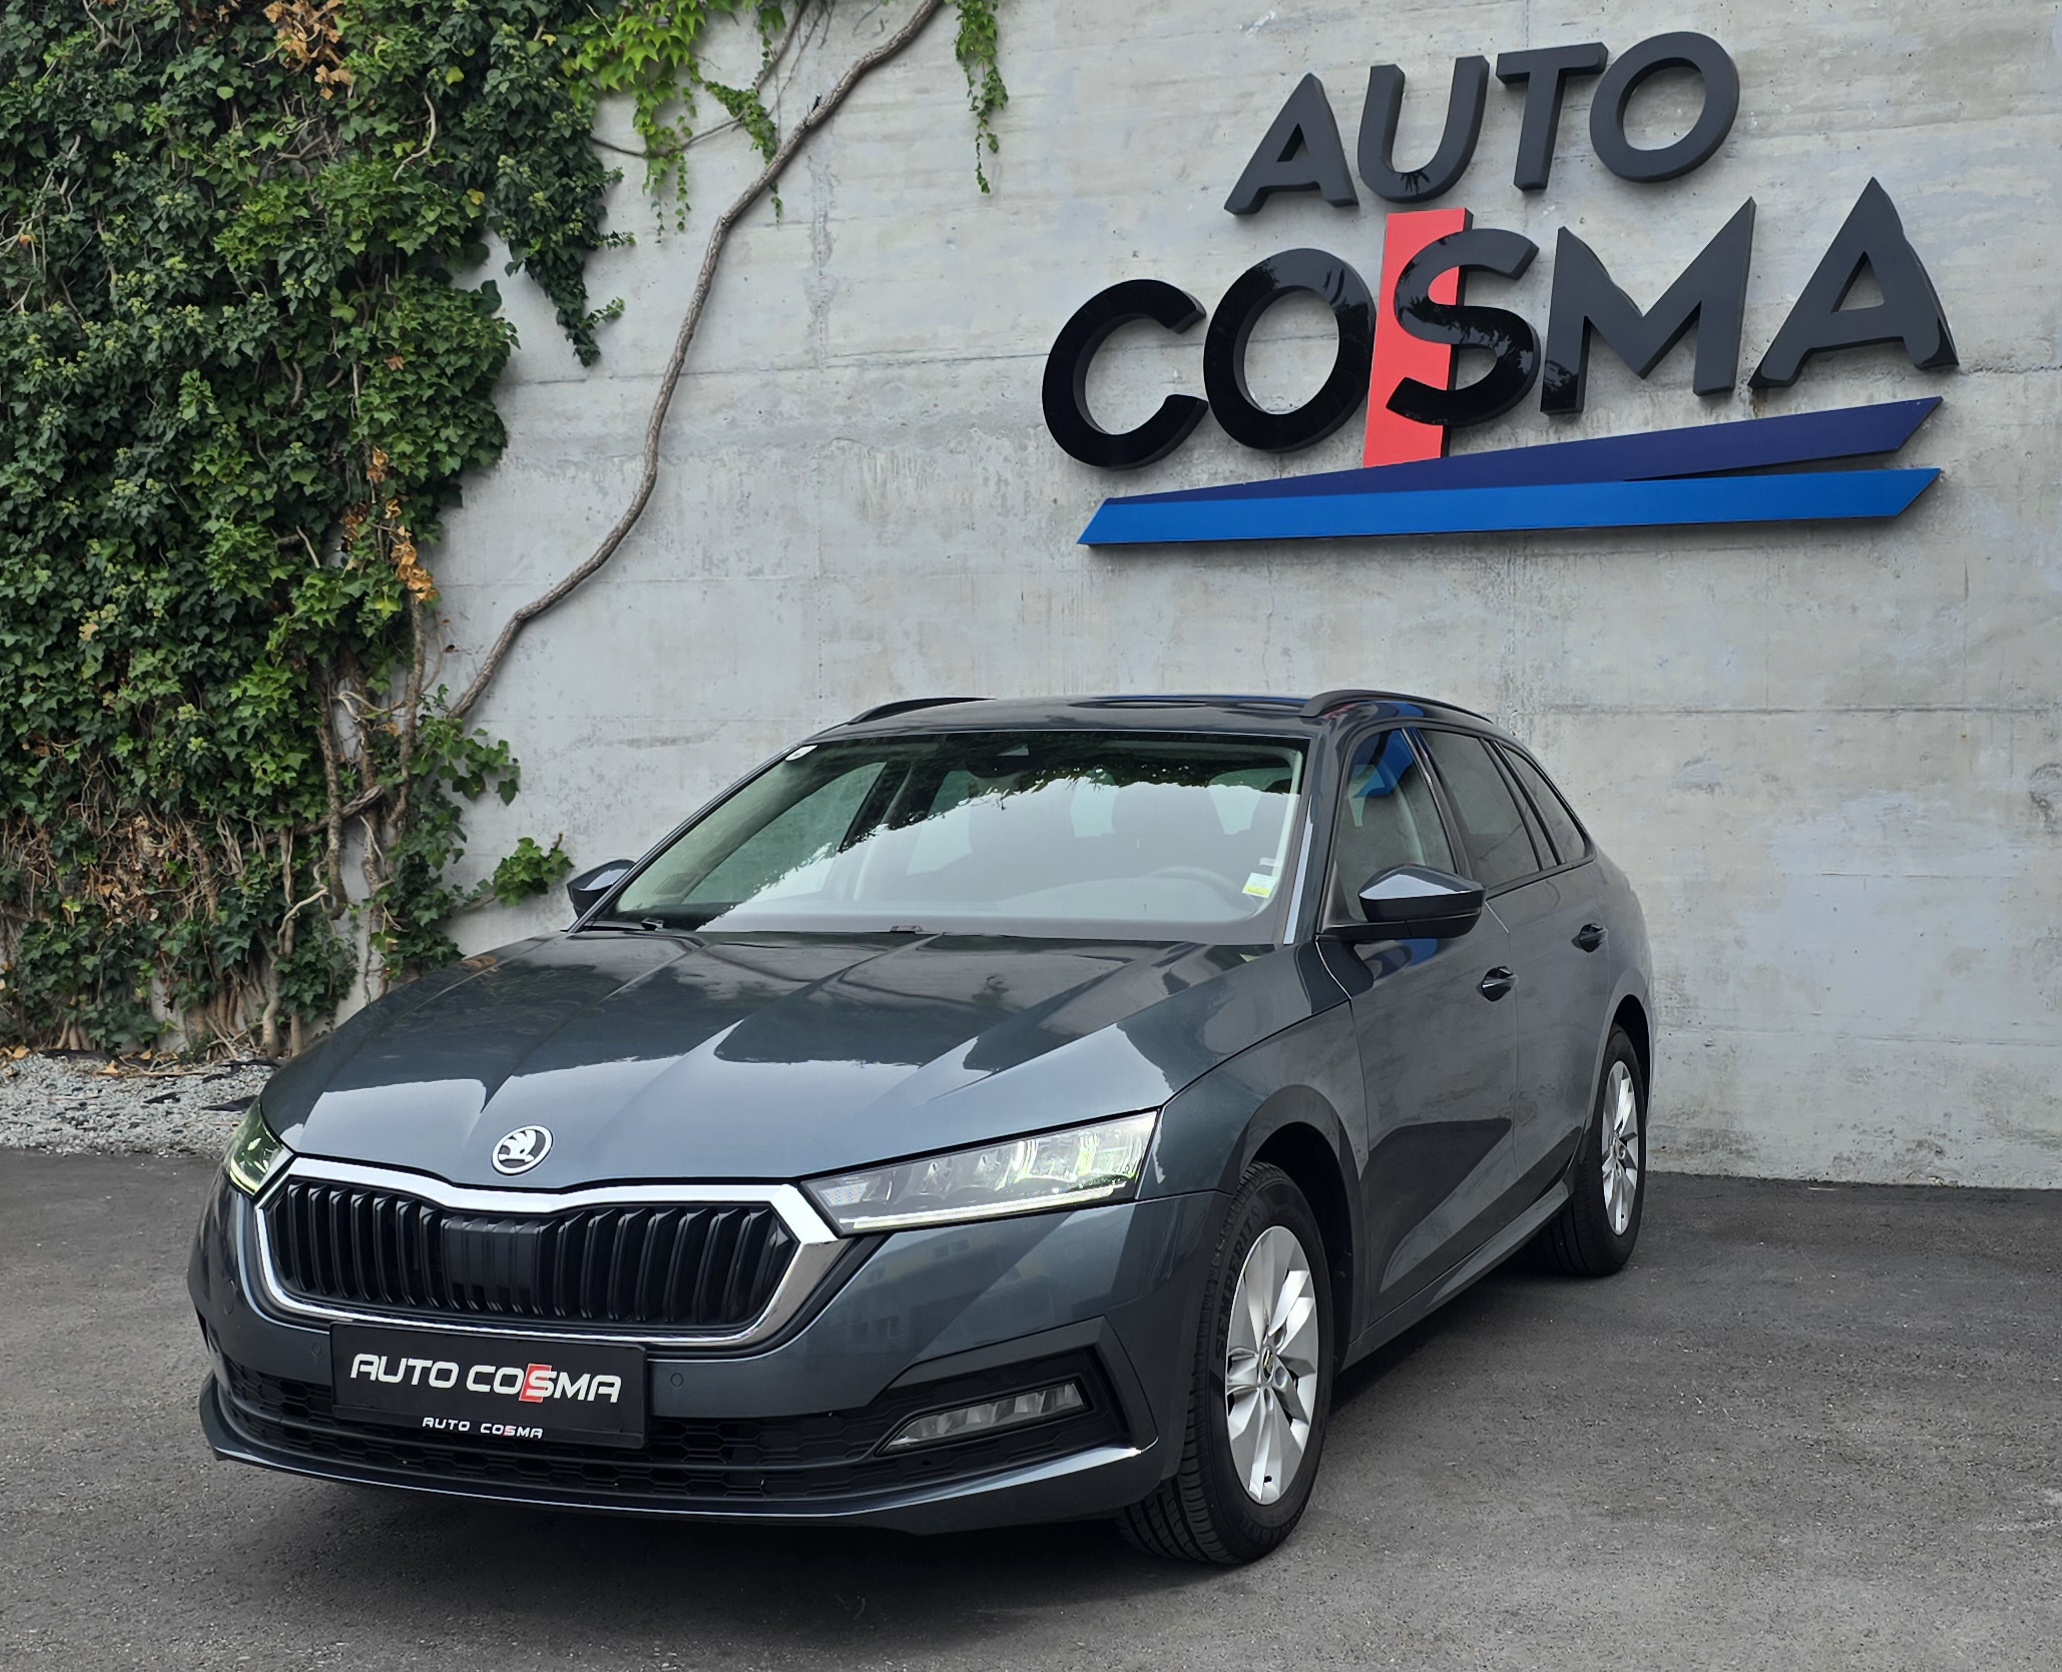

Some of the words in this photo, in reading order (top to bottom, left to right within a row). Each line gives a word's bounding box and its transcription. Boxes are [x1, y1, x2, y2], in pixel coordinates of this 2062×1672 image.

[1224, 31, 1740, 217] AUTO
[1042, 176, 1959, 472] COSMA
[350, 1353, 460, 1389] AUTO
[466, 1363, 622, 1403] COSMA
[422, 1416, 471, 1432] AUTO
[480, 1422, 544, 1440] COSMA
